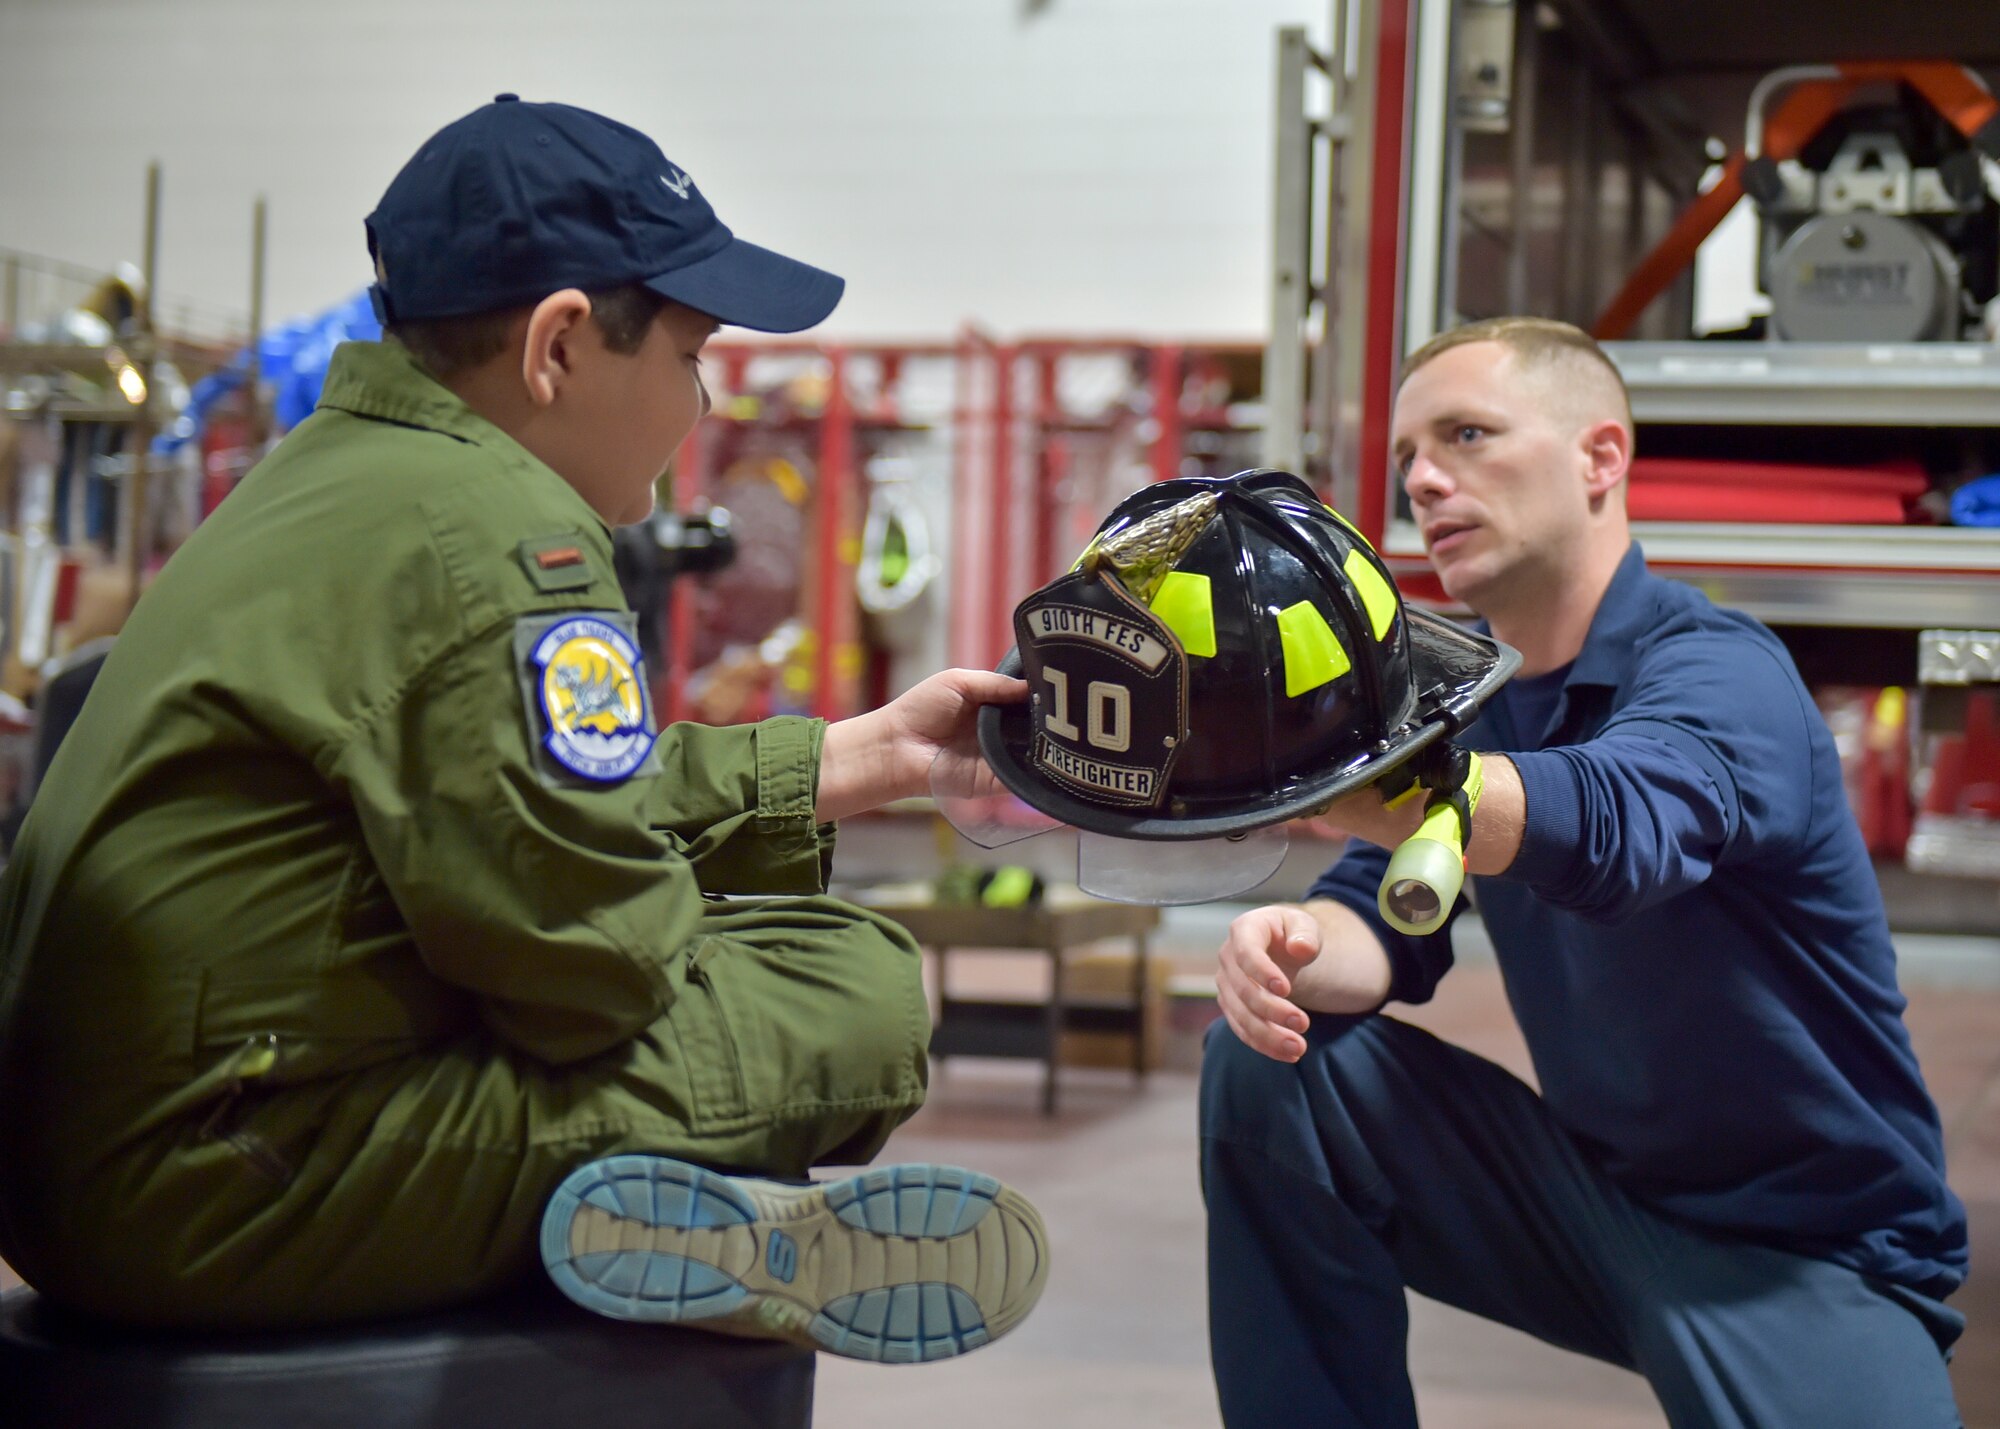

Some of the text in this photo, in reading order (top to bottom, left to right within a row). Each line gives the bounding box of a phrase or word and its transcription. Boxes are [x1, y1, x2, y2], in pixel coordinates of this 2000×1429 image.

[1042, 609, 1146, 654] 910TH FES
[1042, 665, 1131, 753] 10
[1043, 738, 1150, 795] FIREFIGHTER
